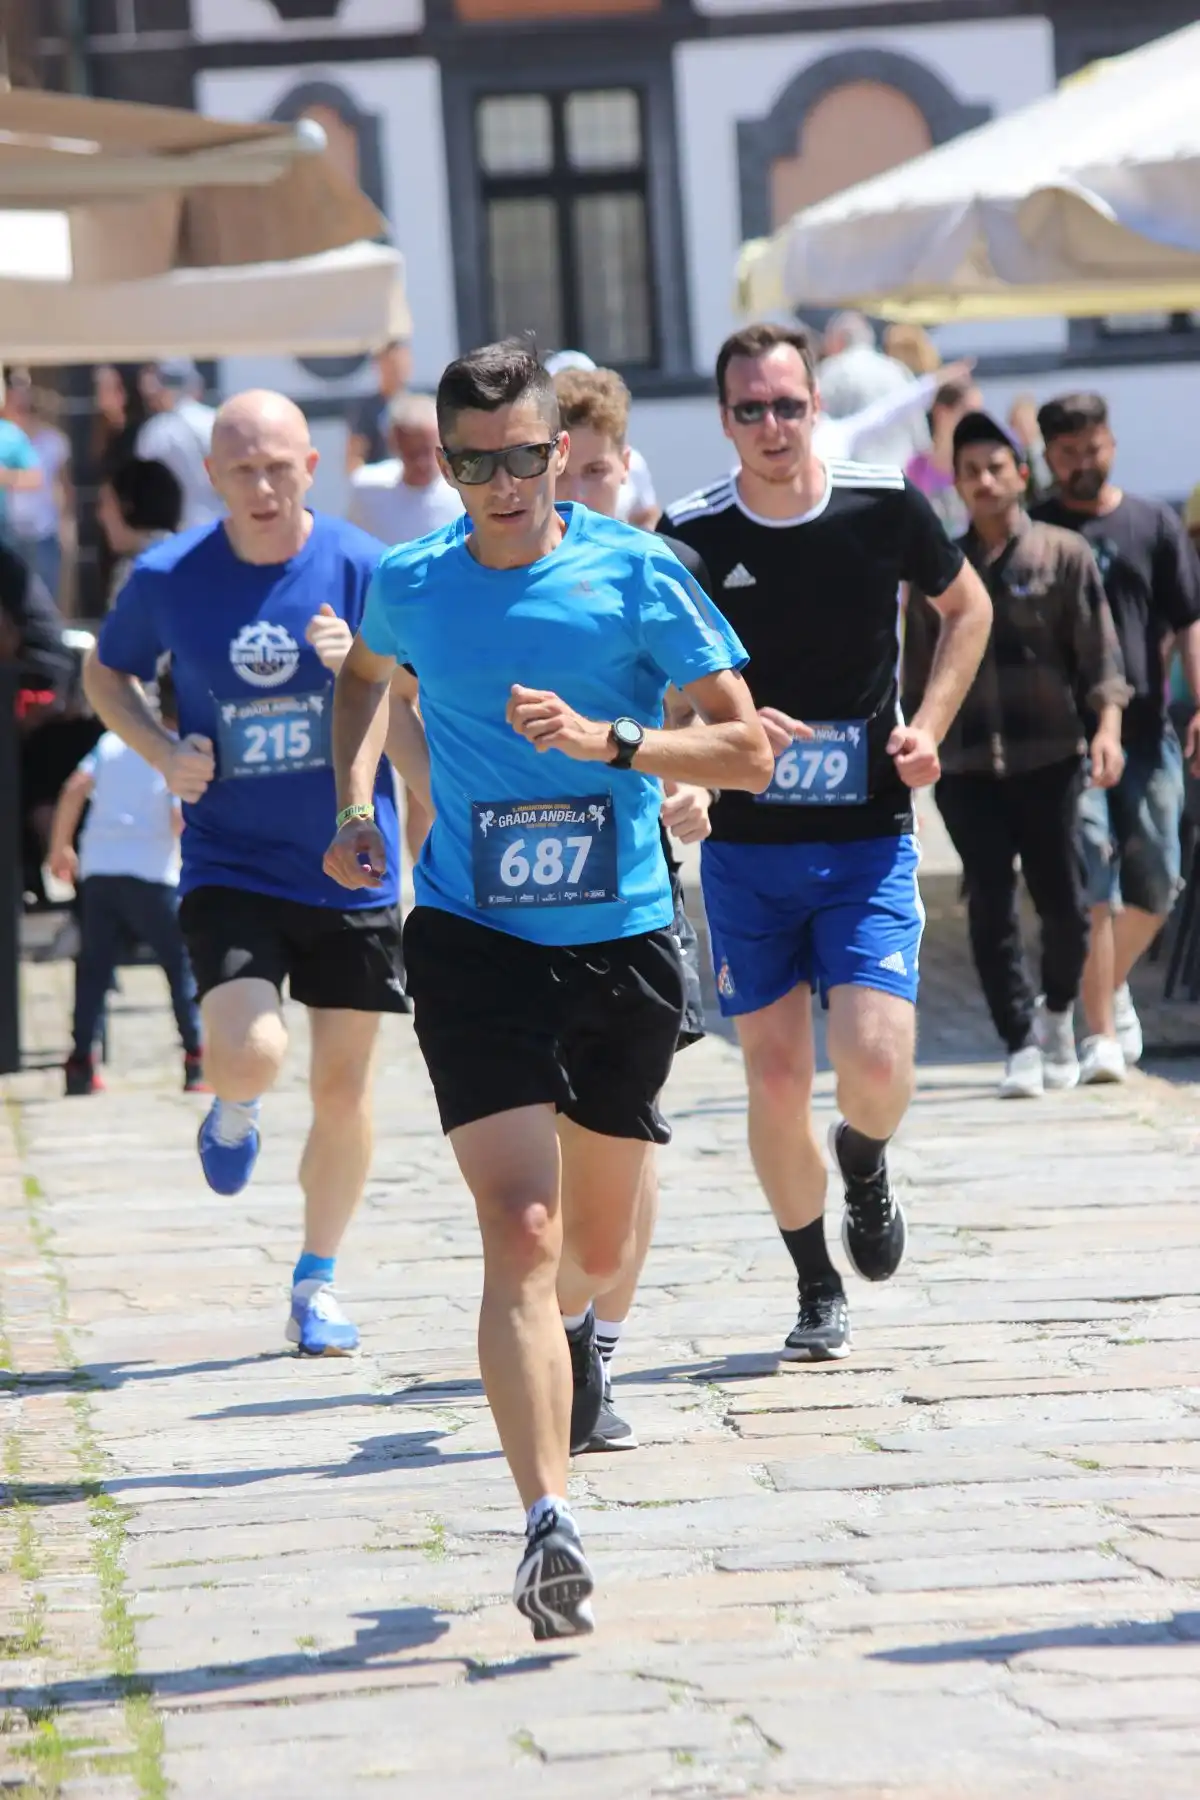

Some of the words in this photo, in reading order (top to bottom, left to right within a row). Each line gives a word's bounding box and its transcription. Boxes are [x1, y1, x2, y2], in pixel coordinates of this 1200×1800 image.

[243, 720, 311, 763] 215
[775, 750, 848, 790] 679
[498, 811, 537, 828] GRADA
[539, 810, 586, 823] ANĐELA
[500, 836, 593, 887] 687
